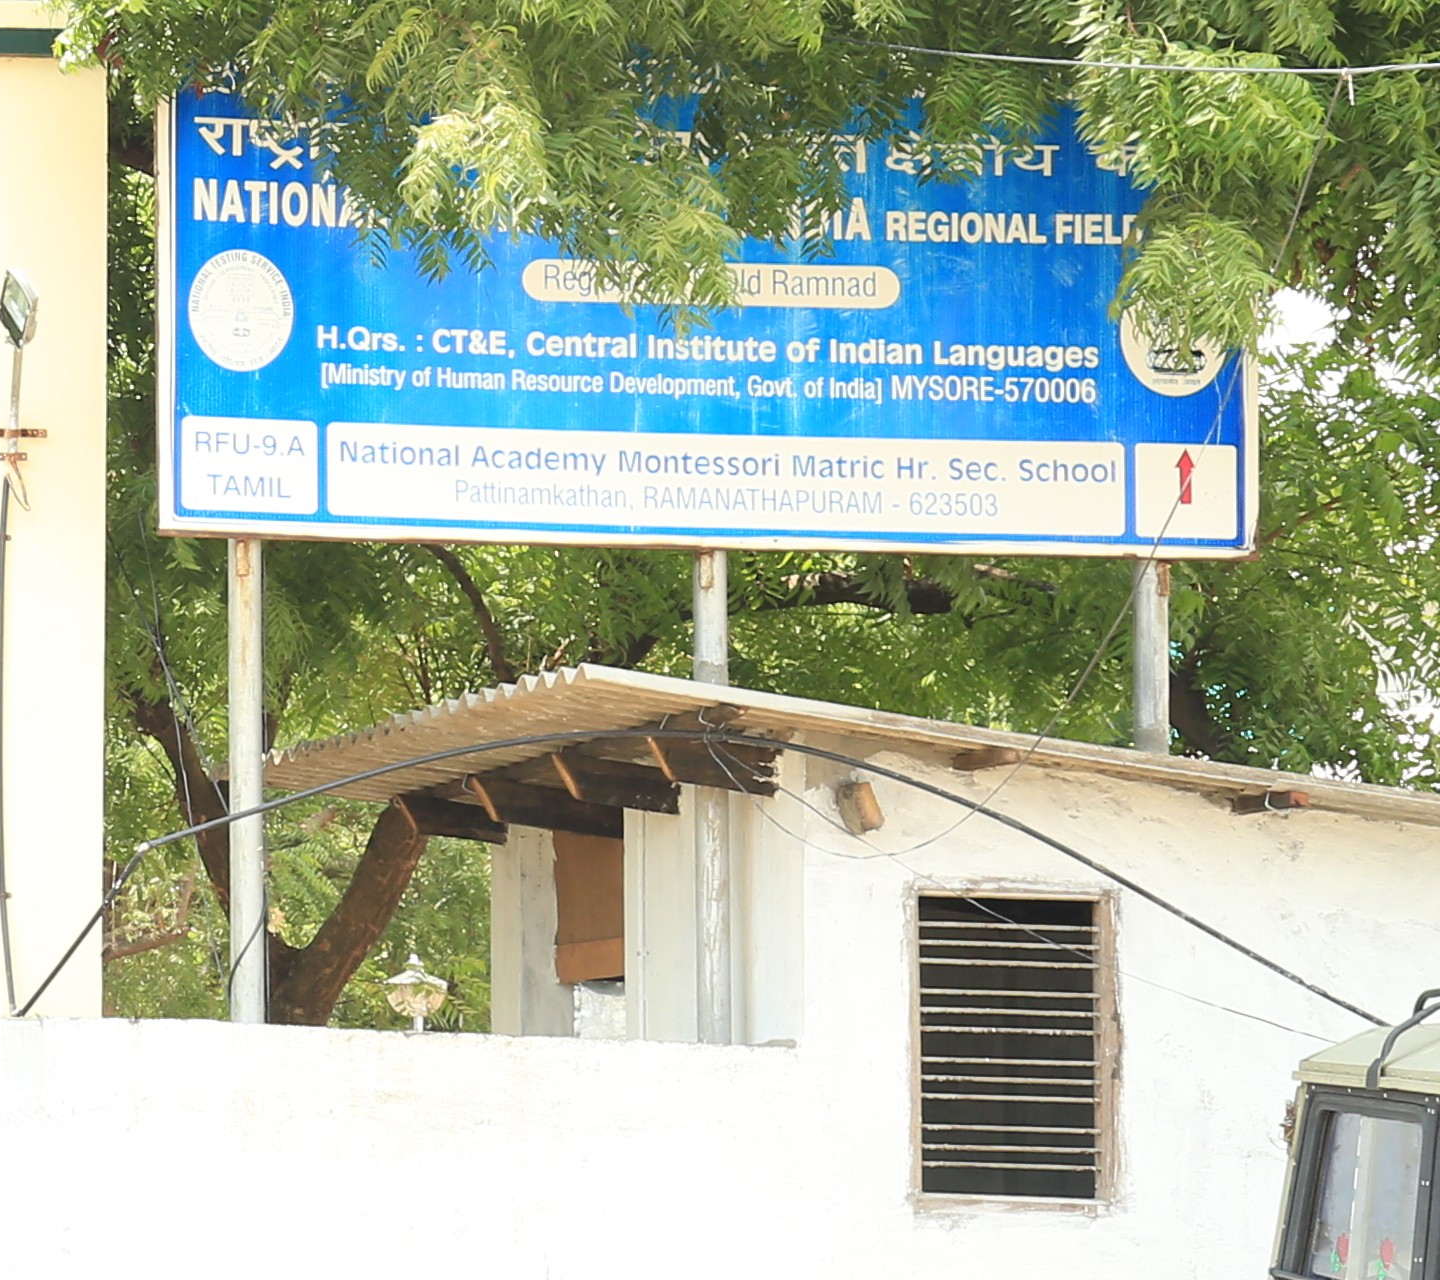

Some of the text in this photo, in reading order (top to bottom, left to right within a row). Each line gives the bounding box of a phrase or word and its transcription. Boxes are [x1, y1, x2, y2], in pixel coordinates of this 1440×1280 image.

[194, 178, 390, 229] NATION
[886, 211, 1047, 244] REGIONAL
[192, 269, 212, 312] NATIONAL
[212, 252, 247, 269] TESTING
[771, 269, 876, 298] Ramnad
[317, 325, 1099, 370] H.Qrs. CT&E, Central Institute of Indian Languages
[412, 368, 432, 387] of
[437, 368, 505, 390] Human
[511, 370, 603, 393] Resource
[609, 372, 740, 400] Development,
[747, 375, 796, 401] Govt.
[804, 376, 822, 399] of
[892, 375, 1097, 404] MYSORE-570006
[340, 440, 1116, 483] National Academy Montessori Matric Hr. Sec. School
[208, 472, 290, 500] TAMIL
[455, 480, 999, 517] Pattinamkathan, RAMANATHAPURAM 623503
